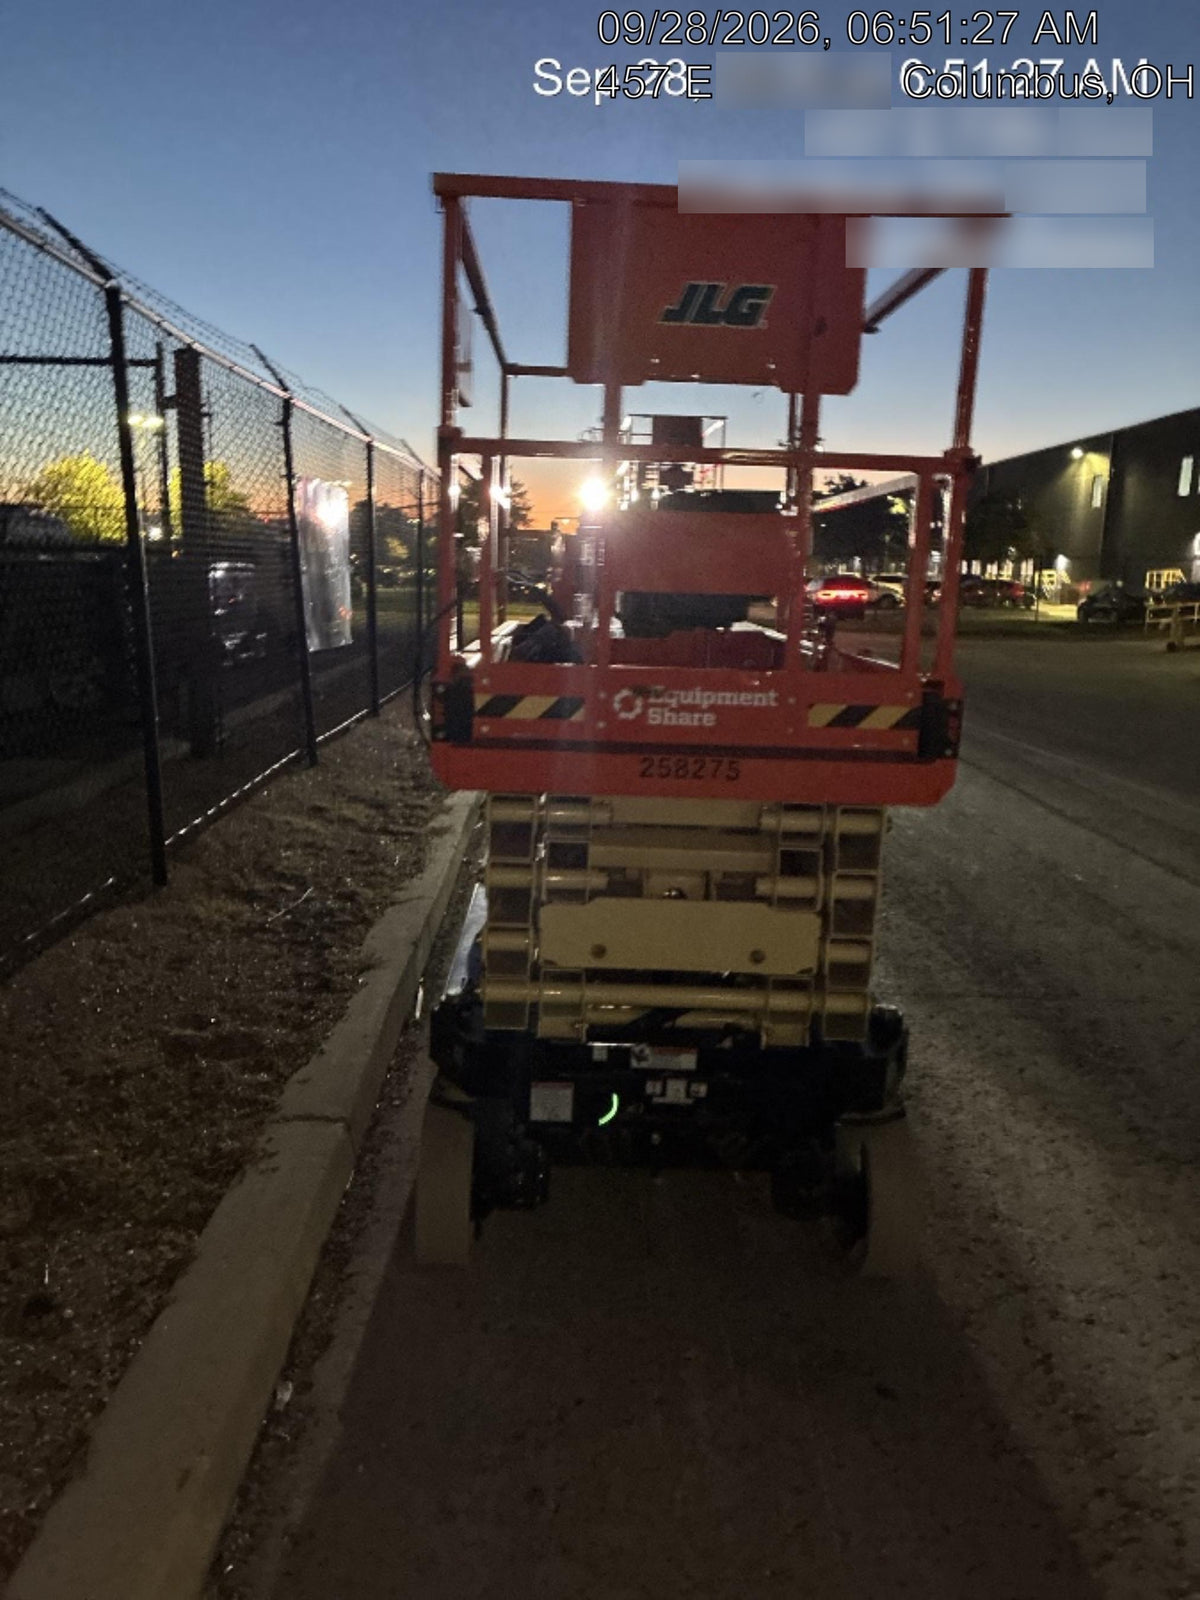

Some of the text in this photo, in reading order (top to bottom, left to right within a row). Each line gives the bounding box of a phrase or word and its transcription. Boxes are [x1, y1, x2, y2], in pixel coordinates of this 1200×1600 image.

[657, 280, 777, 329] JLG
[647, 707, 717, 727] Share
[639, 756, 741, 782] 258275
